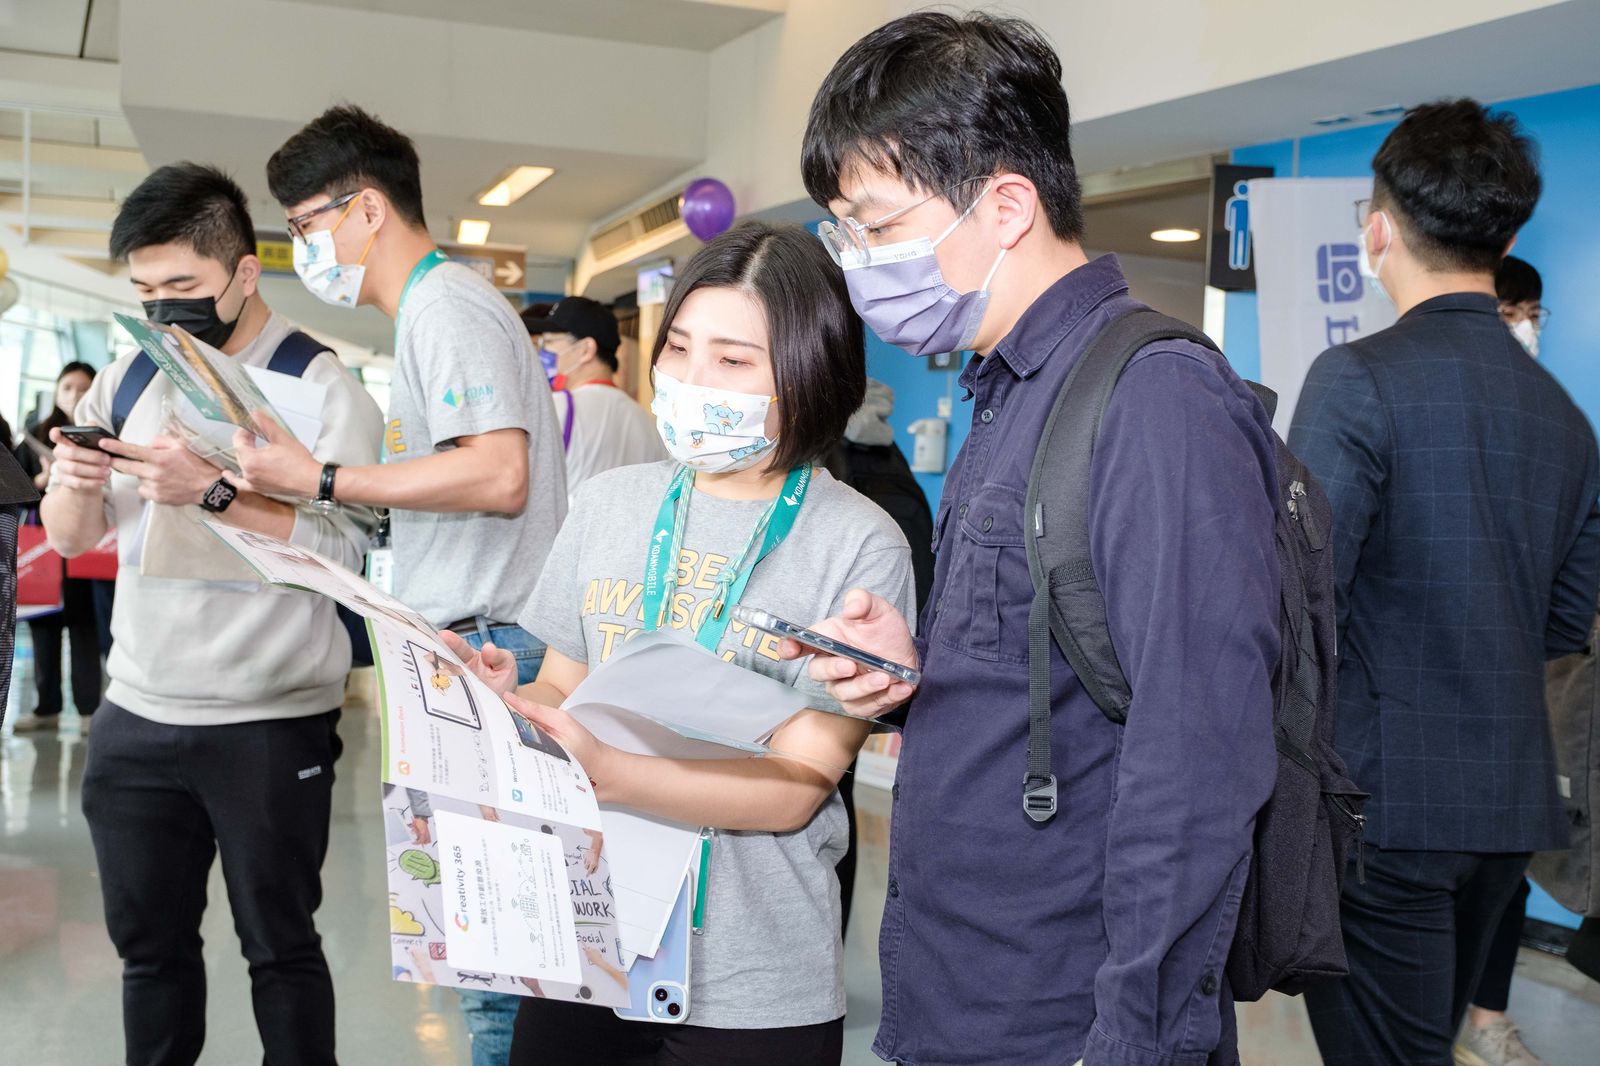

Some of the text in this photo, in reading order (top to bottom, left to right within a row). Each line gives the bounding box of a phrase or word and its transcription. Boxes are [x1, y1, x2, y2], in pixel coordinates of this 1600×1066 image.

[646, 543, 662, 596] KDANMOBILE
[677, 548, 729, 590] BE
[452, 845, 470, 932] Creativity 365
